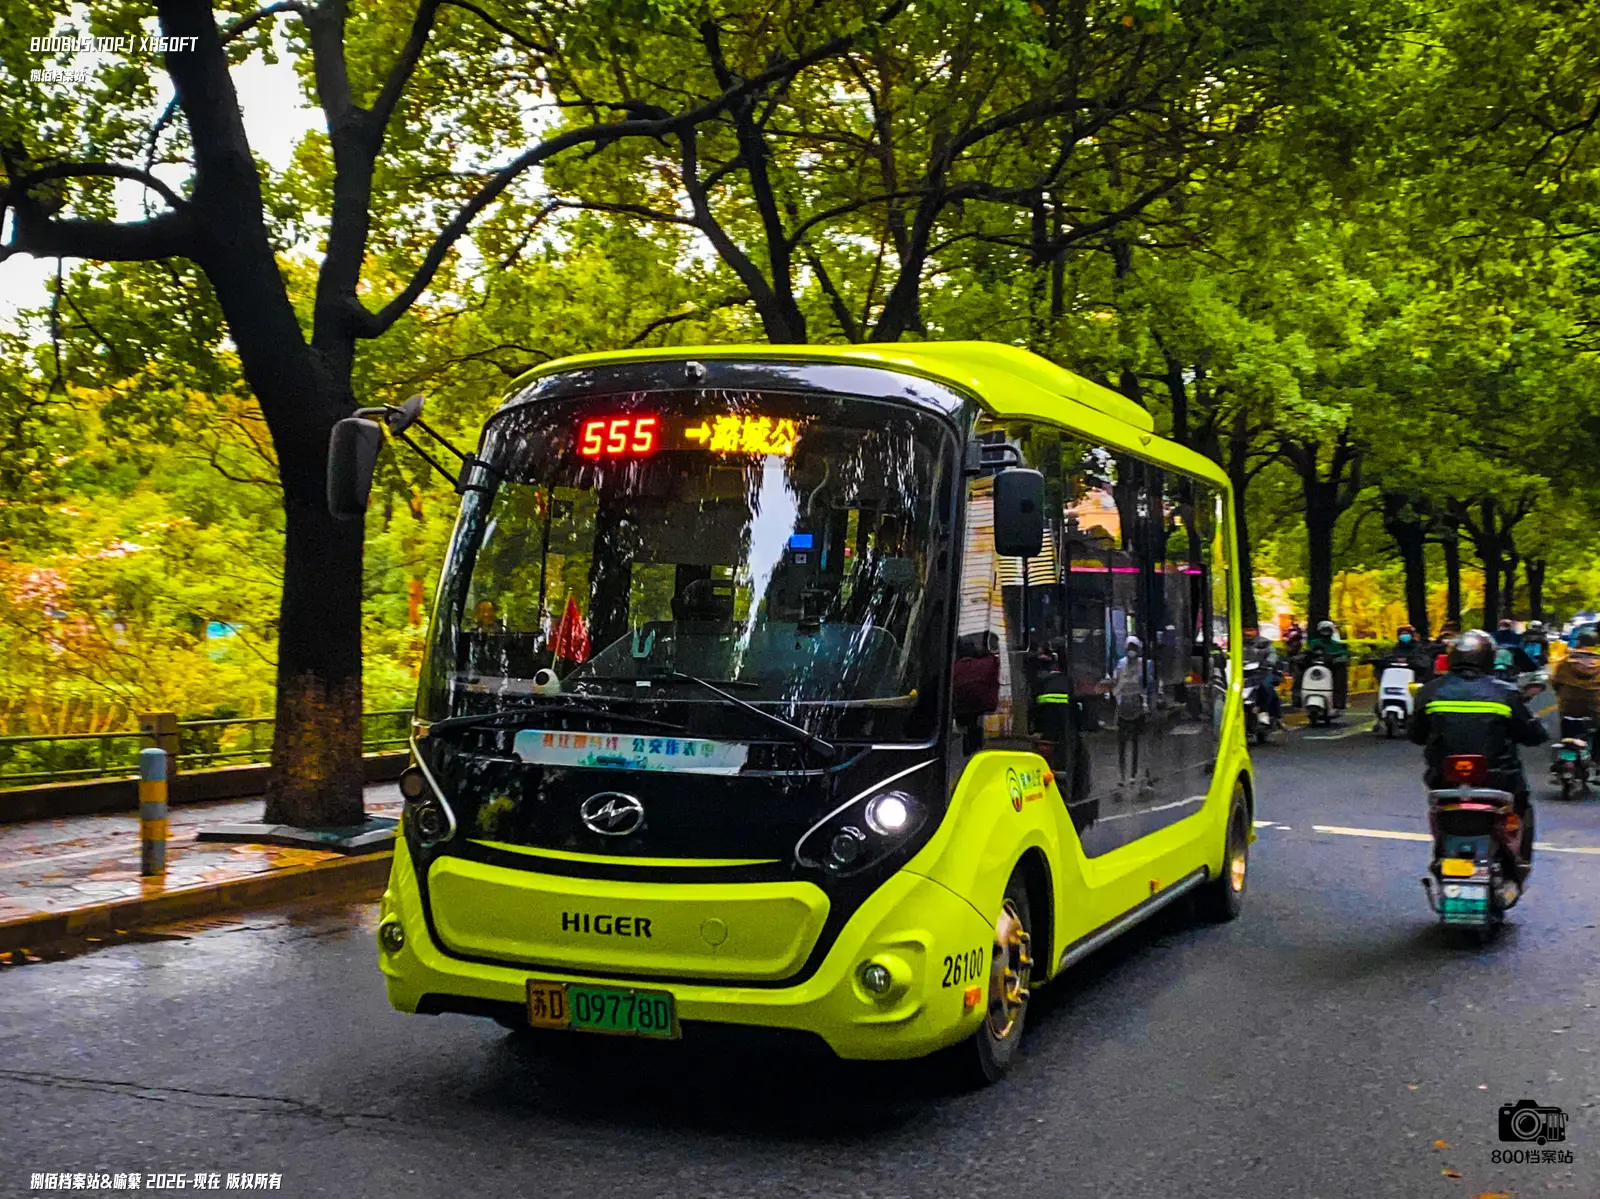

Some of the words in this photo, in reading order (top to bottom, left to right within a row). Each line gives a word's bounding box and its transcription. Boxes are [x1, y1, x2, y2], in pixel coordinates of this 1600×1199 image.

[582, 418, 656, 455] 555
[561, 911, 652, 938] HIGER
[942, 946, 983, 989] 26100
[575, 992, 668, 1030] 09778D
